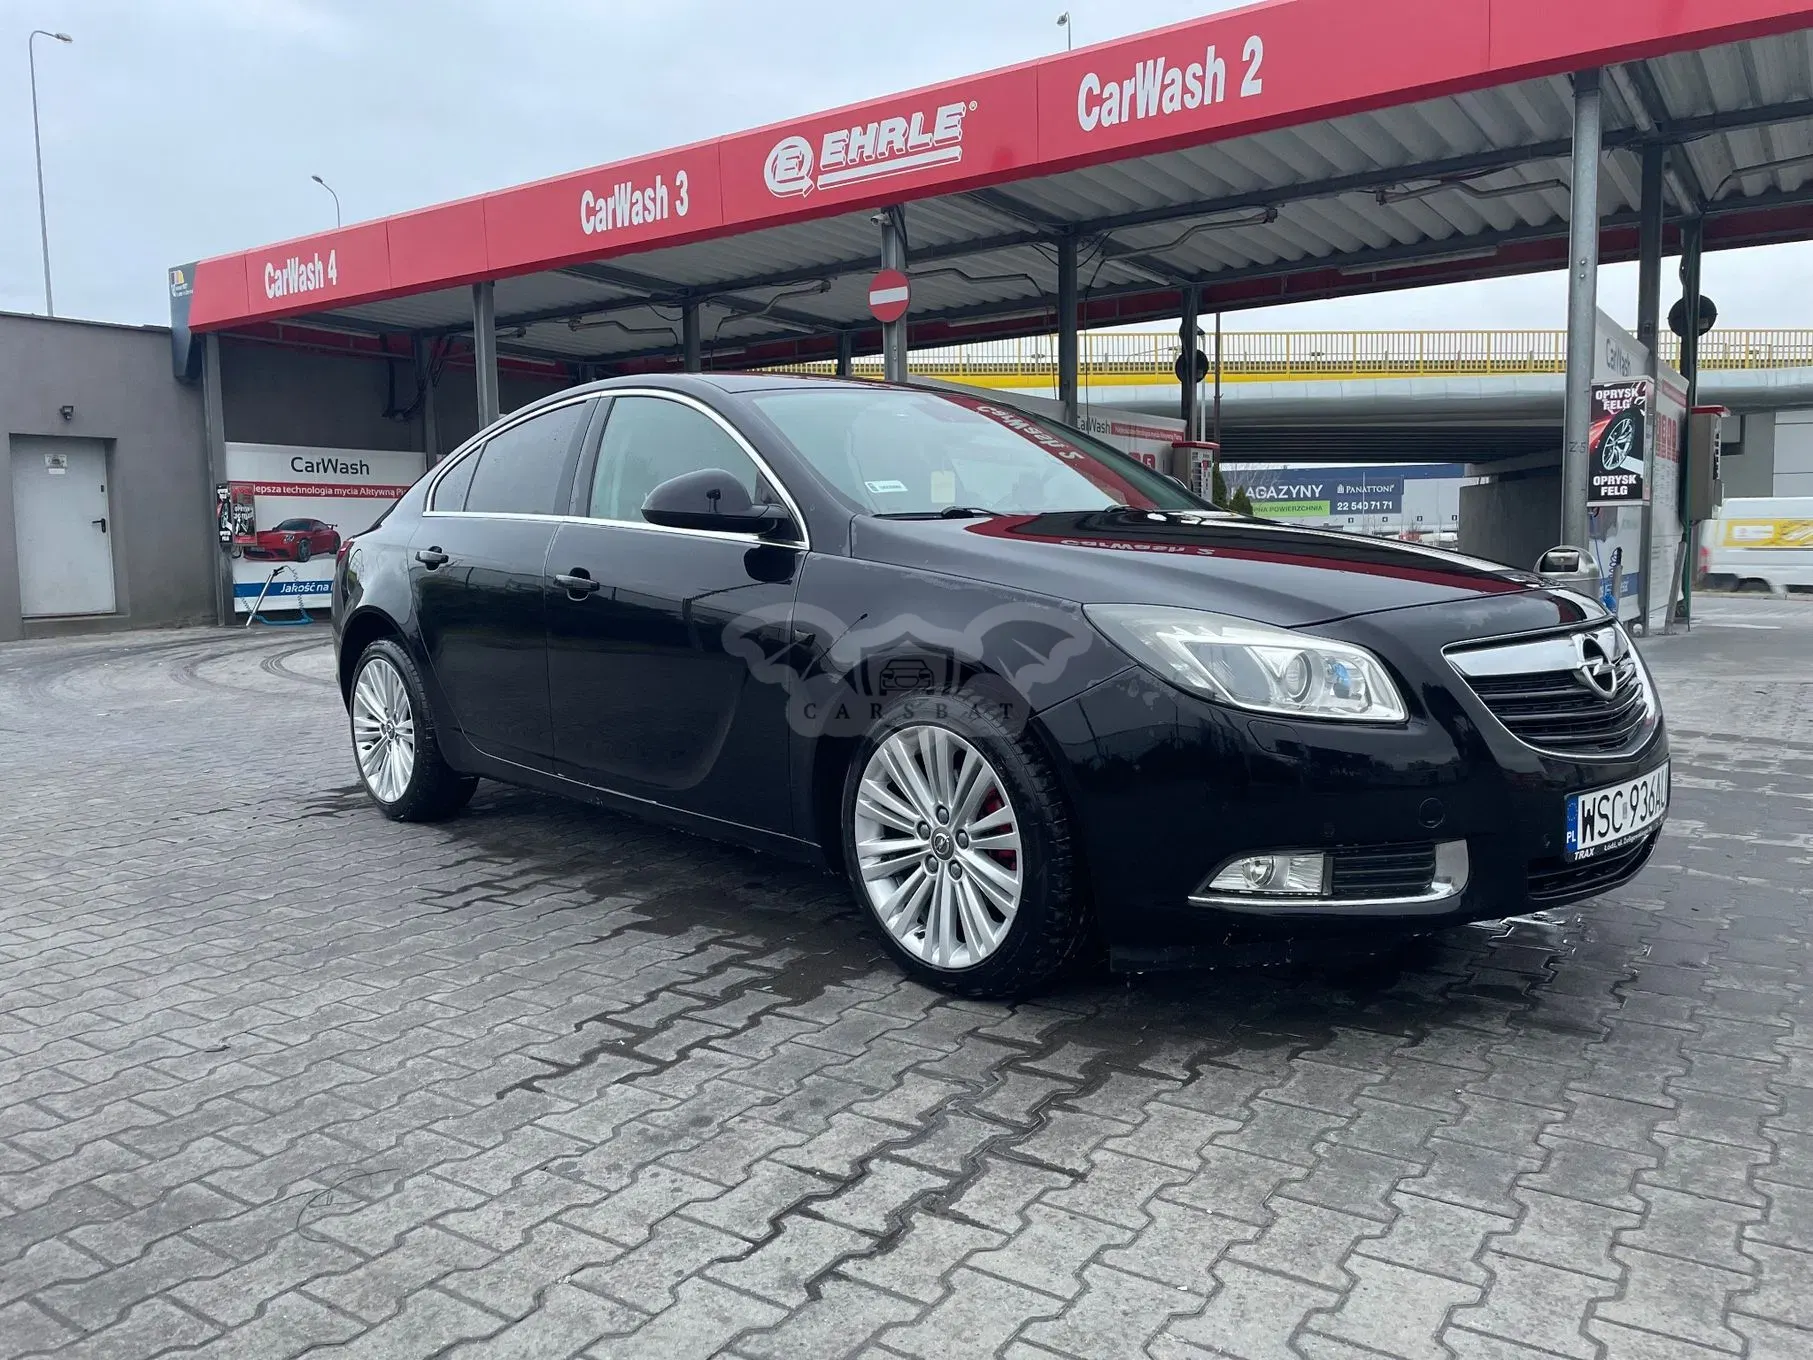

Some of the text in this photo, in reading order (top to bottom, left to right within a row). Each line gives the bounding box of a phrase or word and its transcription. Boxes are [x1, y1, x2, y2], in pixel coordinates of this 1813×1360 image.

[1077, 35, 1264, 132] CarWash 2
[820, 102, 966, 171] EHRLE
[580, 170, 689, 235] CarWash 3
[264, 250, 337, 299] CarWash 4
[1595, 387, 1638, 401] OPRYSK
[1603, 400, 1631, 411] FELG
[290, 456, 370, 475] CarWash
[1593, 475, 1636, 486] OPRYSK
[253, 485, 408, 497] lepsza technologia mycia Aktywną Pi
[1231, 484, 1323, 499] AGAZYNY
[1600, 486, 1628, 496] FELG
[1337, 502, 1393, 511] 22 540 71 71
[280, 582, 315, 594] Jakość
[1566, 832, 1576, 844] PL
[1574, 847, 1595, 861] TRAX
